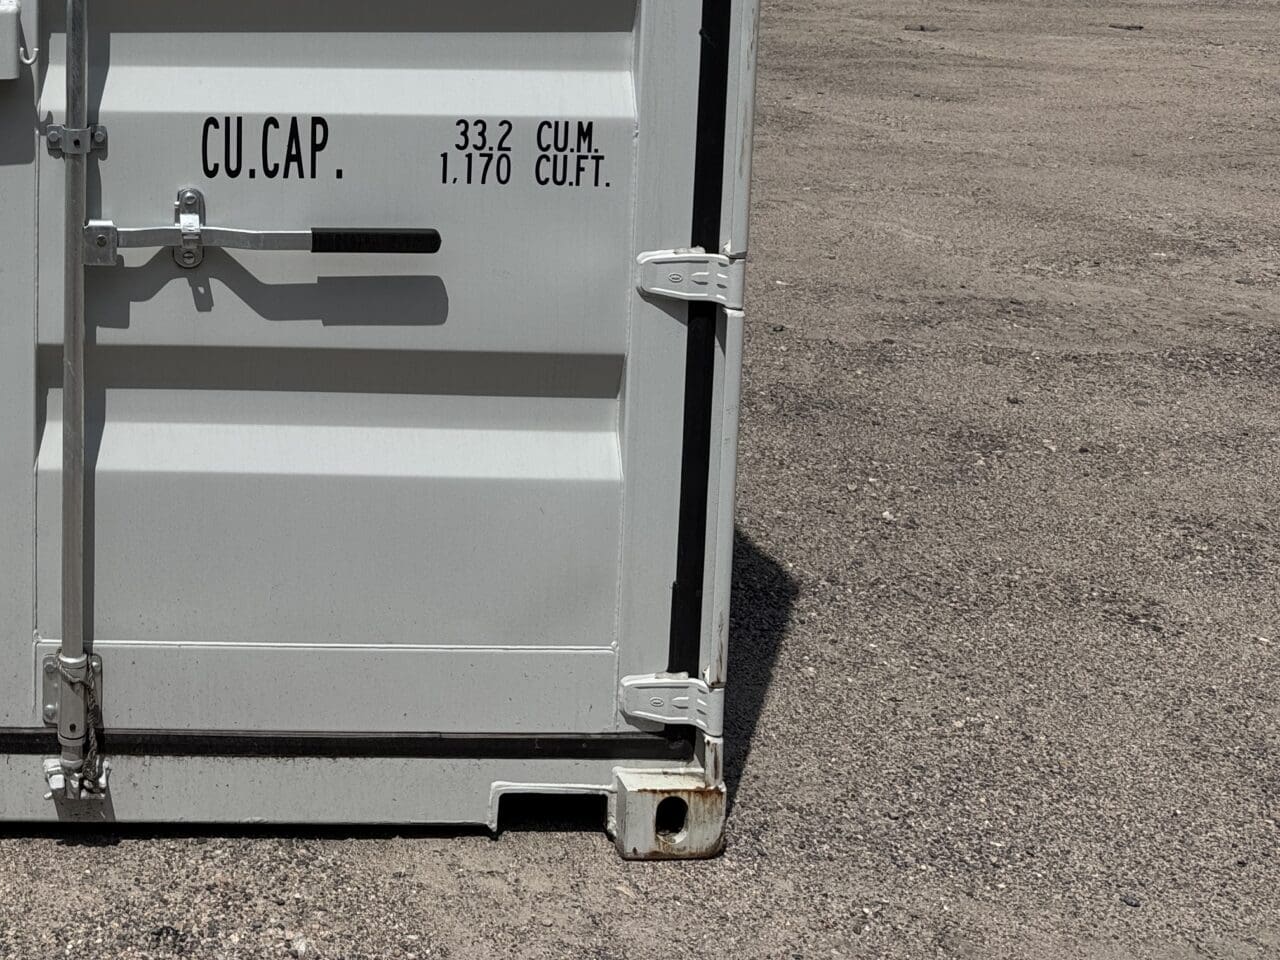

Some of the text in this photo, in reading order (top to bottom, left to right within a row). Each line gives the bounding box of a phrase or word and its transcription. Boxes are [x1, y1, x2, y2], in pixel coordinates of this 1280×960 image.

[202, 116, 599, 179] CU.CAP. 33.2 CU.M.
[440, 152, 610, 187] 1,170 CU.FT.
